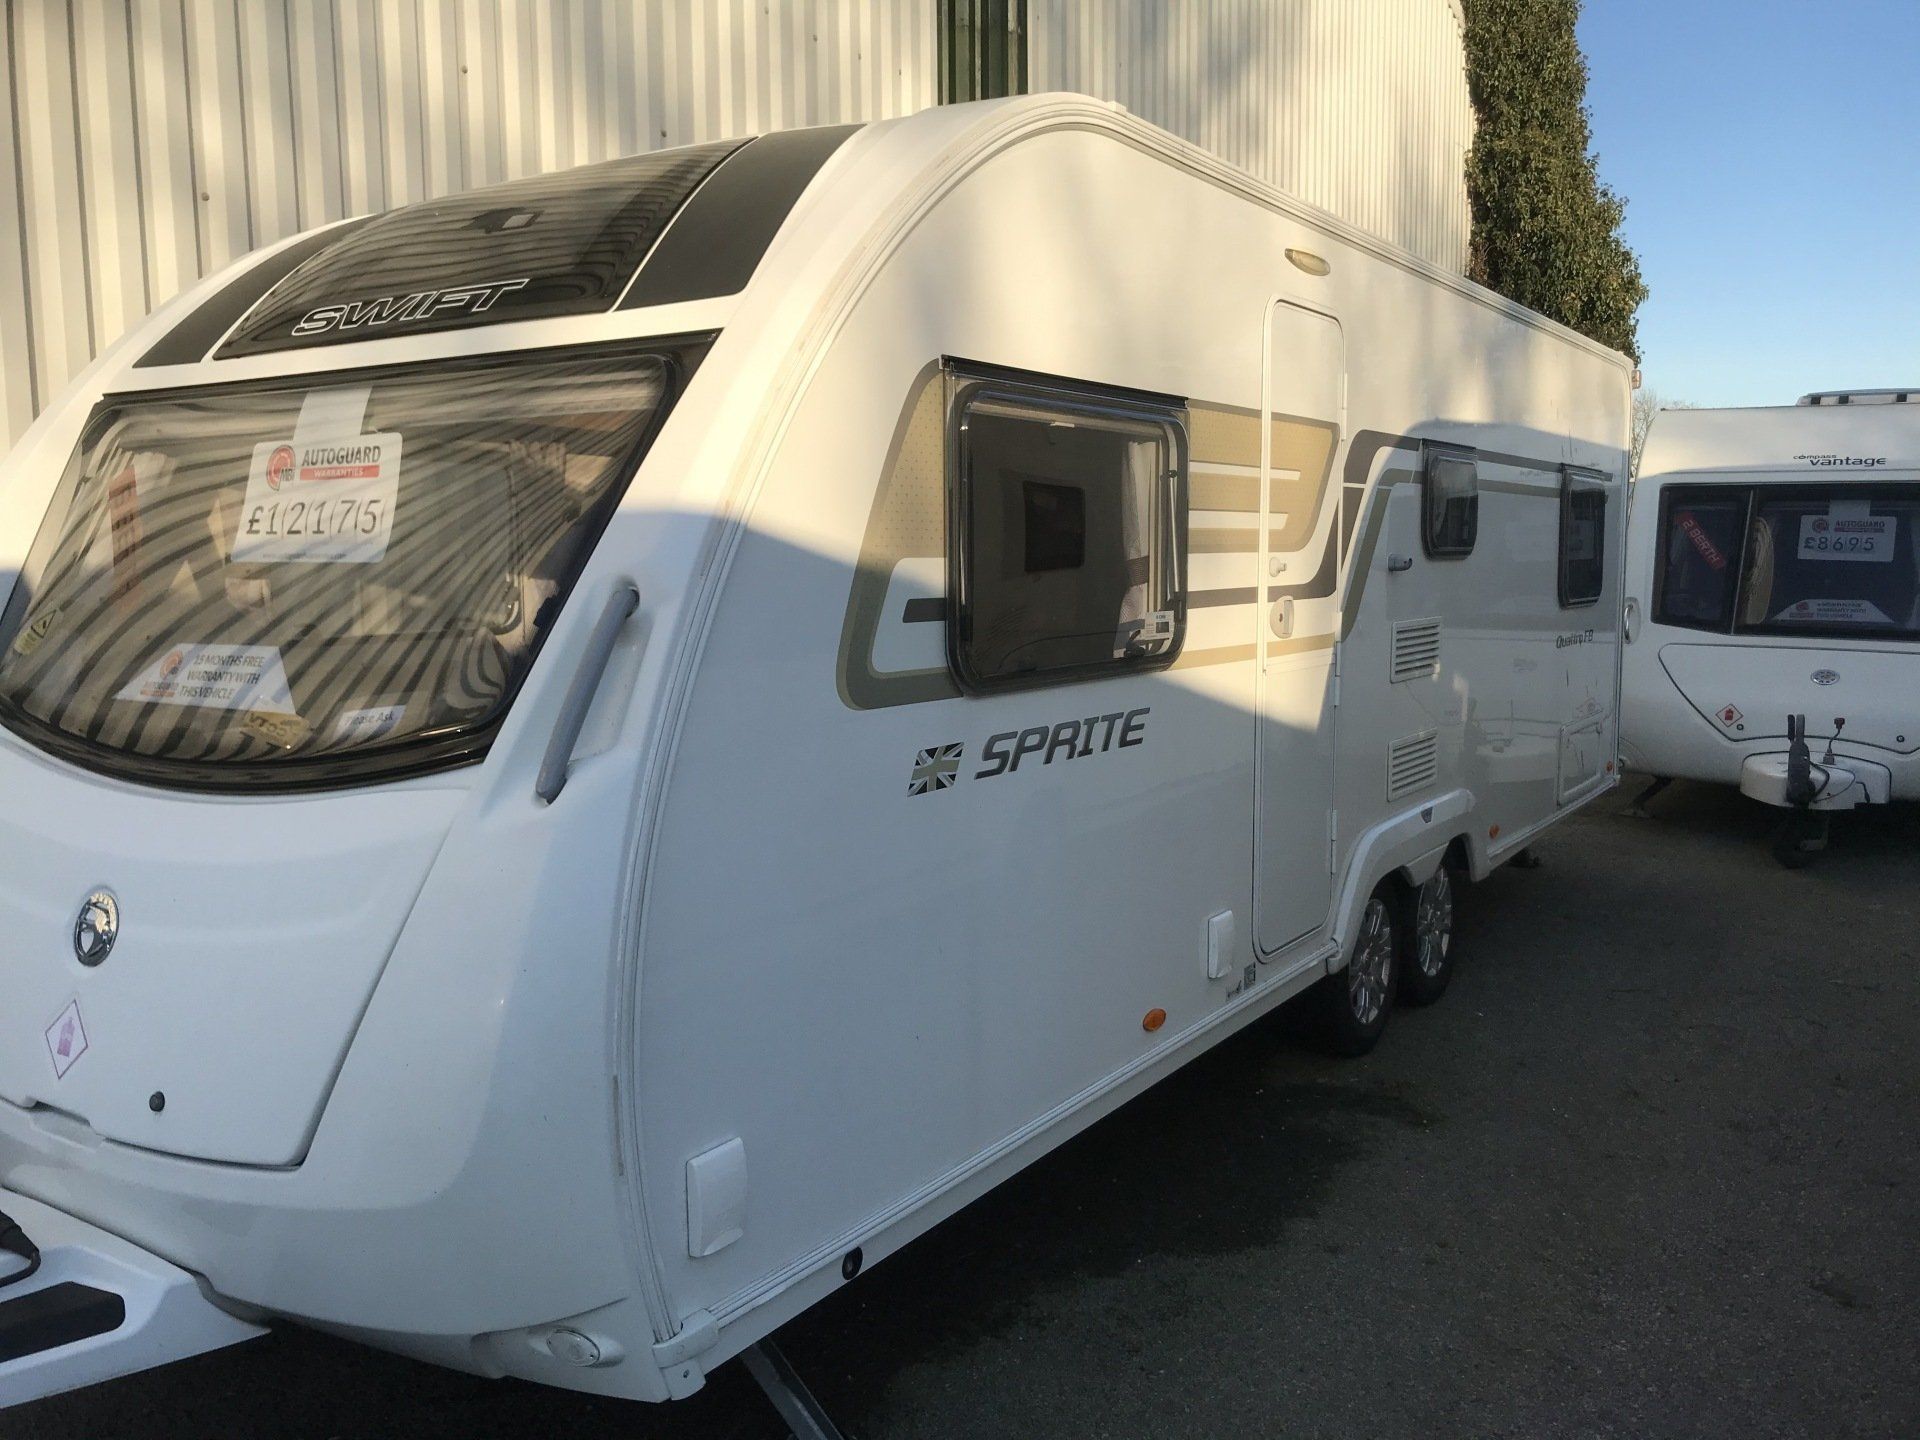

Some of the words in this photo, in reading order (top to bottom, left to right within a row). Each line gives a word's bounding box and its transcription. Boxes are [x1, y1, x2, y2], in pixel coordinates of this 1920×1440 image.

[291, 278, 531, 336] SWIFT
[301, 445, 382, 467] AUTOGUARD
[1809, 456, 1887, 468] vantage
[313, 468, 364, 478] WARRANTIES
[246, 499, 382, 536] £12175
[1804, 536, 1875, 552] £8695
[204, 654, 244, 668] MONTHS
[243, 656, 266, 668] FREE
[187, 670, 236, 684] WARRANTY
[179, 685, 200, 697] THIS
[200, 686, 236, 700] VEHICLE
[974, 707, 1151, 780] SPRITE
